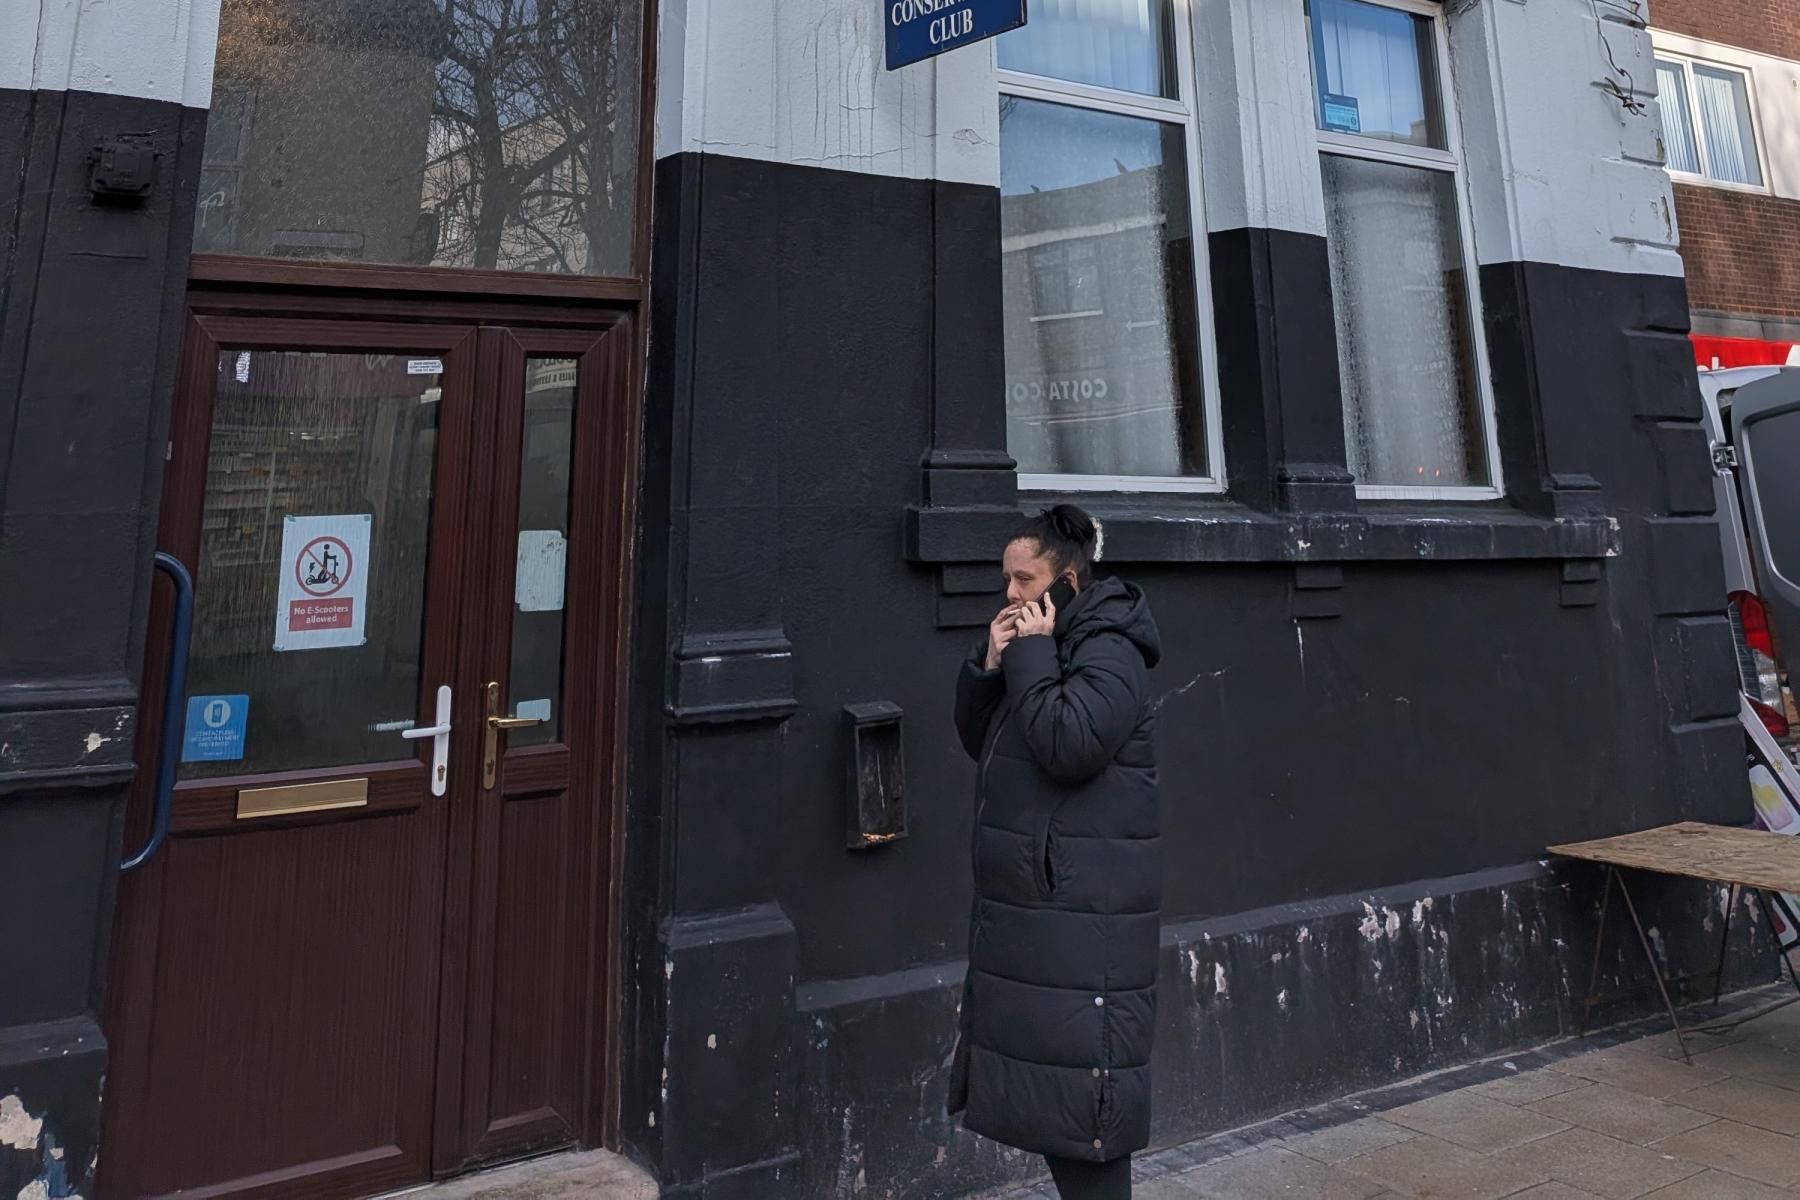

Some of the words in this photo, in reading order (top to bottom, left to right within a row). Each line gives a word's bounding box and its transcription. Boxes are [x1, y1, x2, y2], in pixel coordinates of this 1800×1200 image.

[929, 8, 974, 45] CLUB
[293, 607, 306, 616] No
[306, 604, 350, 615] E-Scooters
[305, 614, 337, 624] allowed
